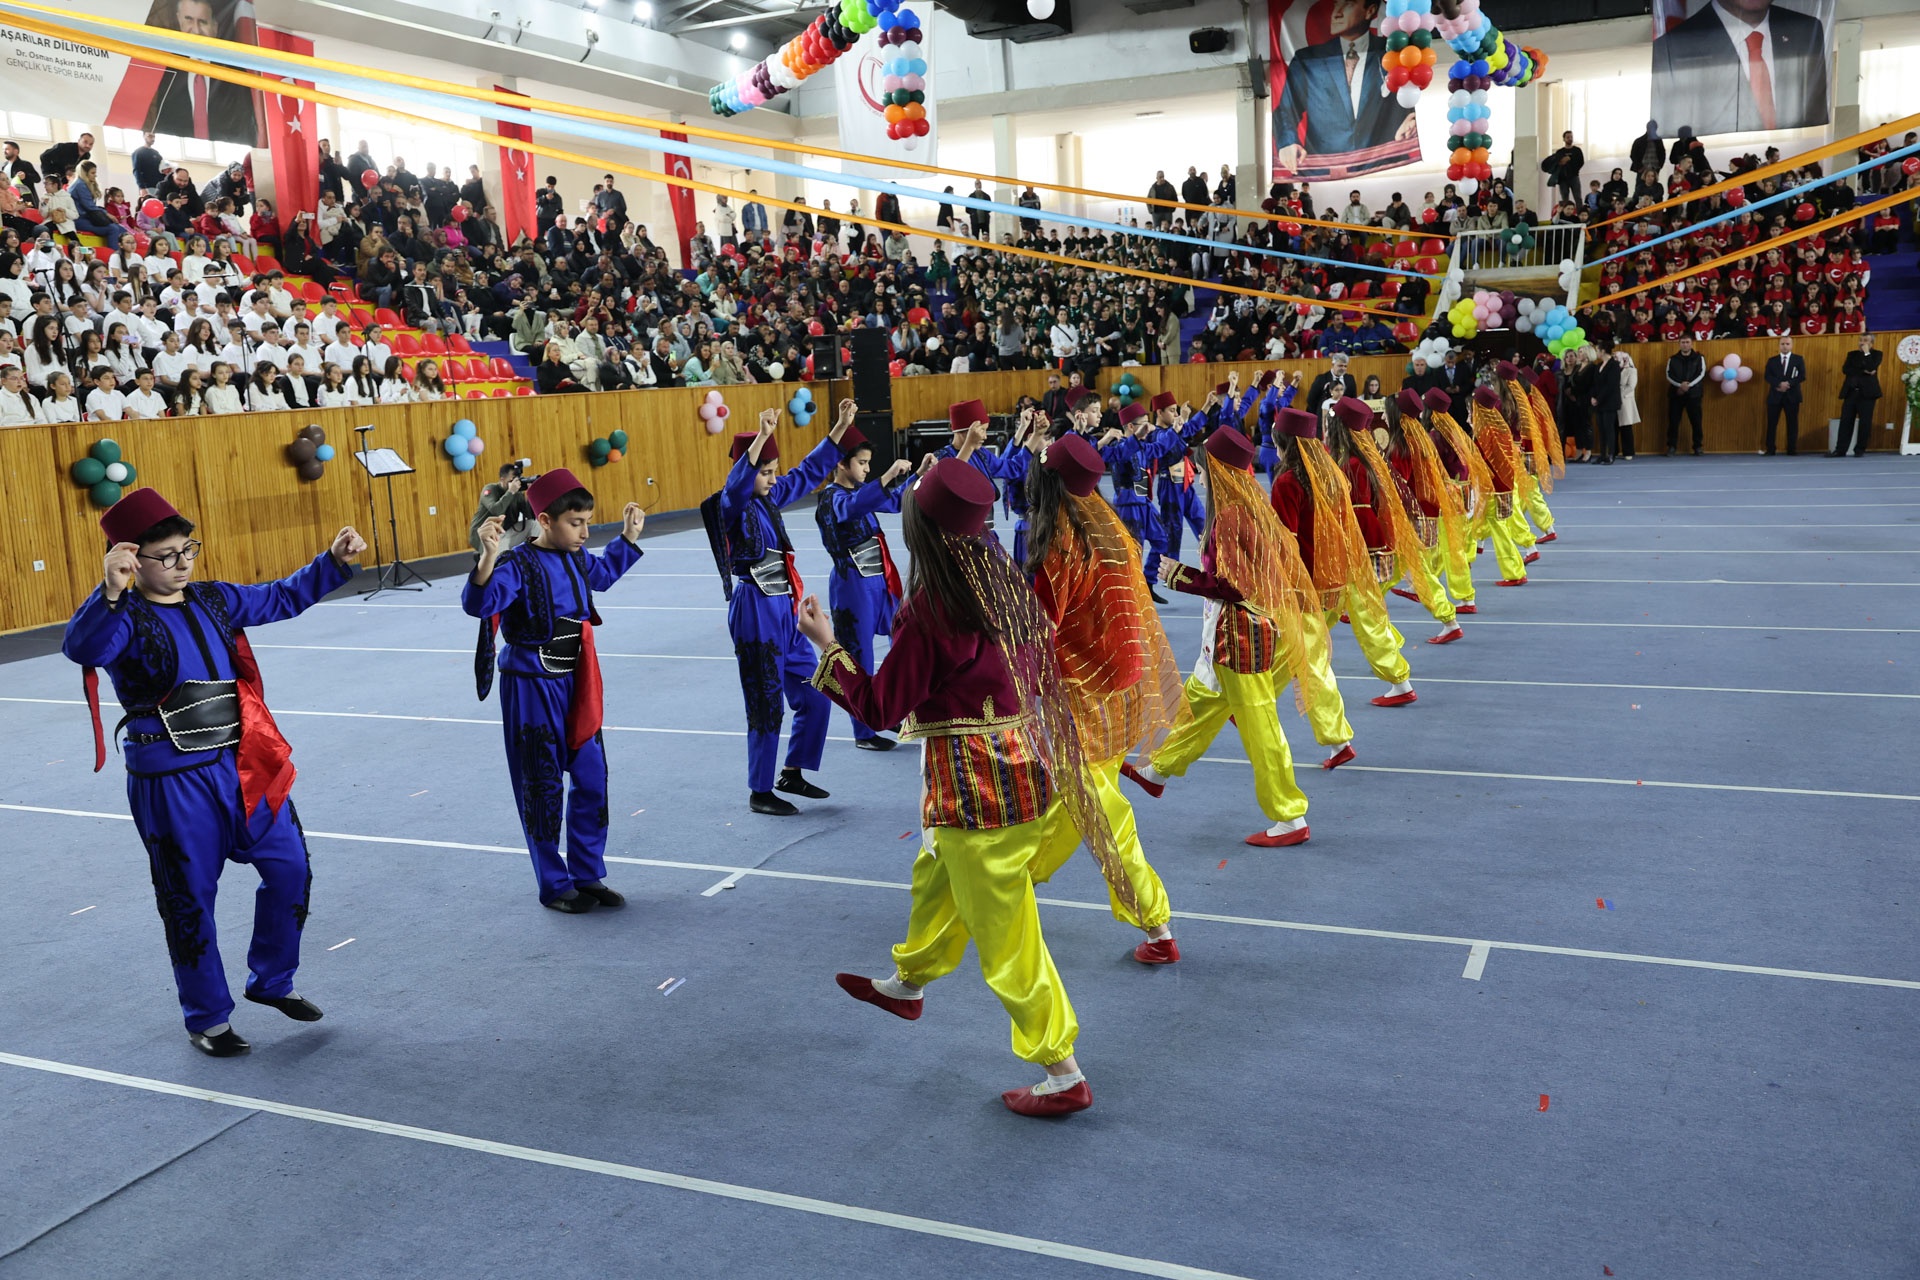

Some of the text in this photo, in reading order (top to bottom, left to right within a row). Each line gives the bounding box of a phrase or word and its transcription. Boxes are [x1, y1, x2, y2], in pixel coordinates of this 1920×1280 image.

[15, 48, 93, 70] Dr. Osman Aşkın BAK
[53, 39, 110, 59] DİLİYORUM
[6, 57, 104, 82] GENÇLİK VE SPOR BAKANI
